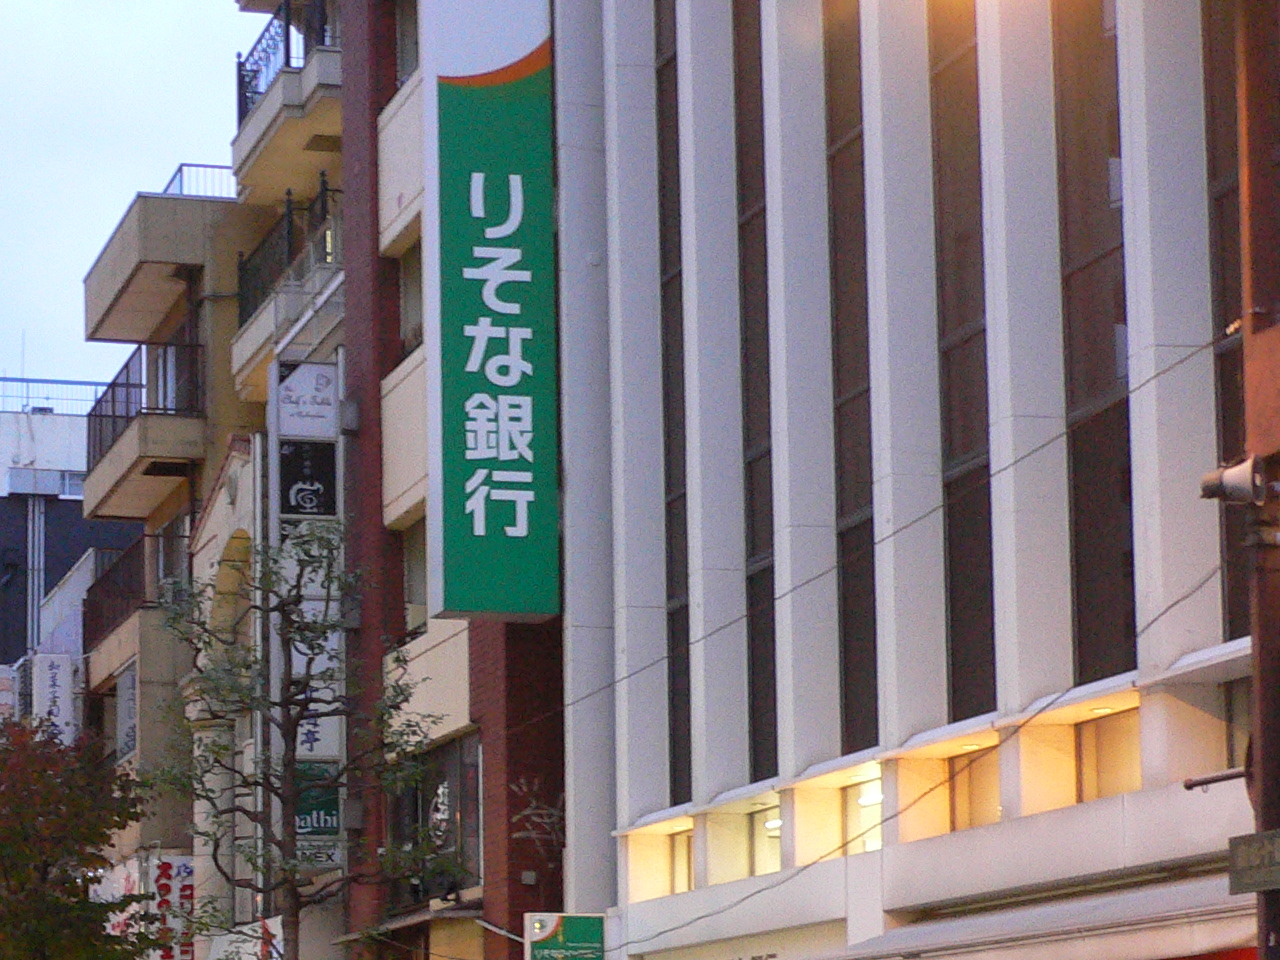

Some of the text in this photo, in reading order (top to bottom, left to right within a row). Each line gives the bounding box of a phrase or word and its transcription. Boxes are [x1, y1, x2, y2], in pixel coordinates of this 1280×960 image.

[462, 172, 535, 538] りそな銀行
